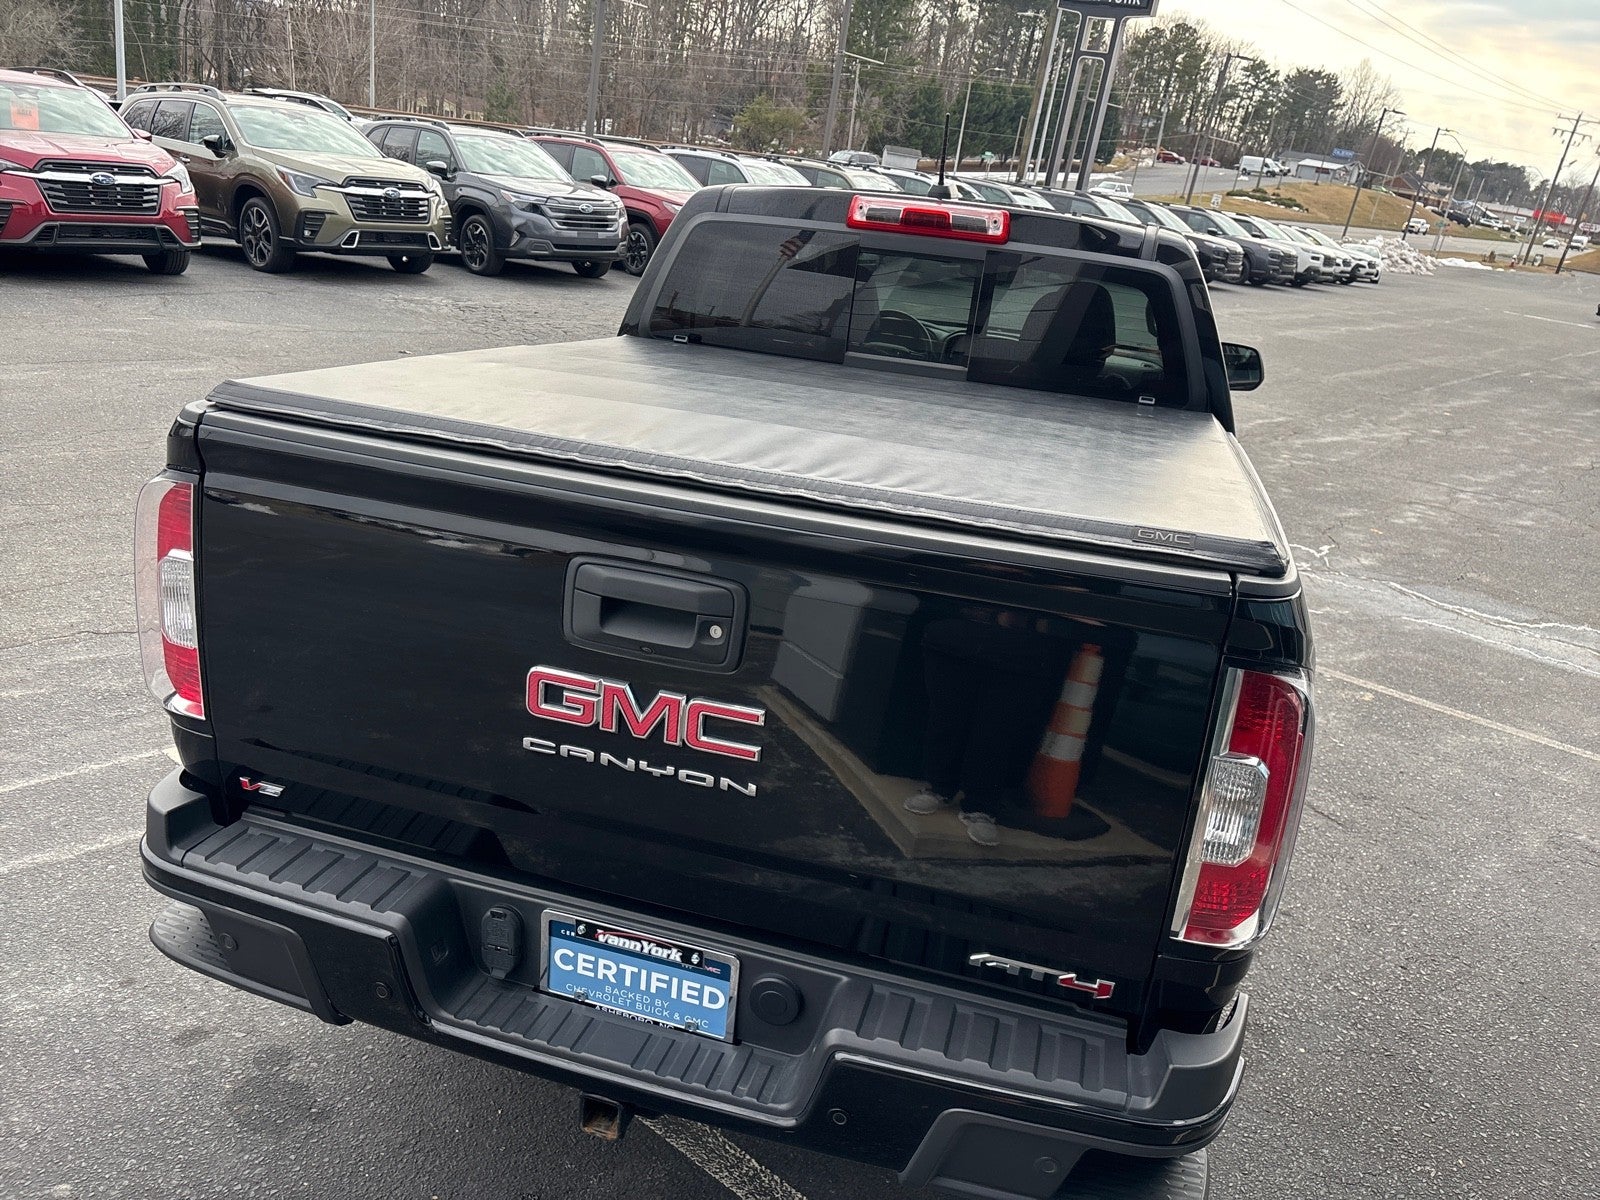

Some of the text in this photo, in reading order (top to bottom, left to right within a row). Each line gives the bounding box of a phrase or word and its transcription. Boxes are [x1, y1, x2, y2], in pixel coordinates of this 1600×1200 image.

[1138, 528, 1191, 545] GMC
[525, 665, 766, 762] GMC
[523, 736, 757, 797] CANYON
[553, 948, 726, 1010] CERTIFIED
[565, 983, 632, 1007] CHEVROLET
[636, 1002, 671, 1018] BUICK
[674, 1012, 681, 1020] &
[605, 985, 670, 1008] BACKED BY
